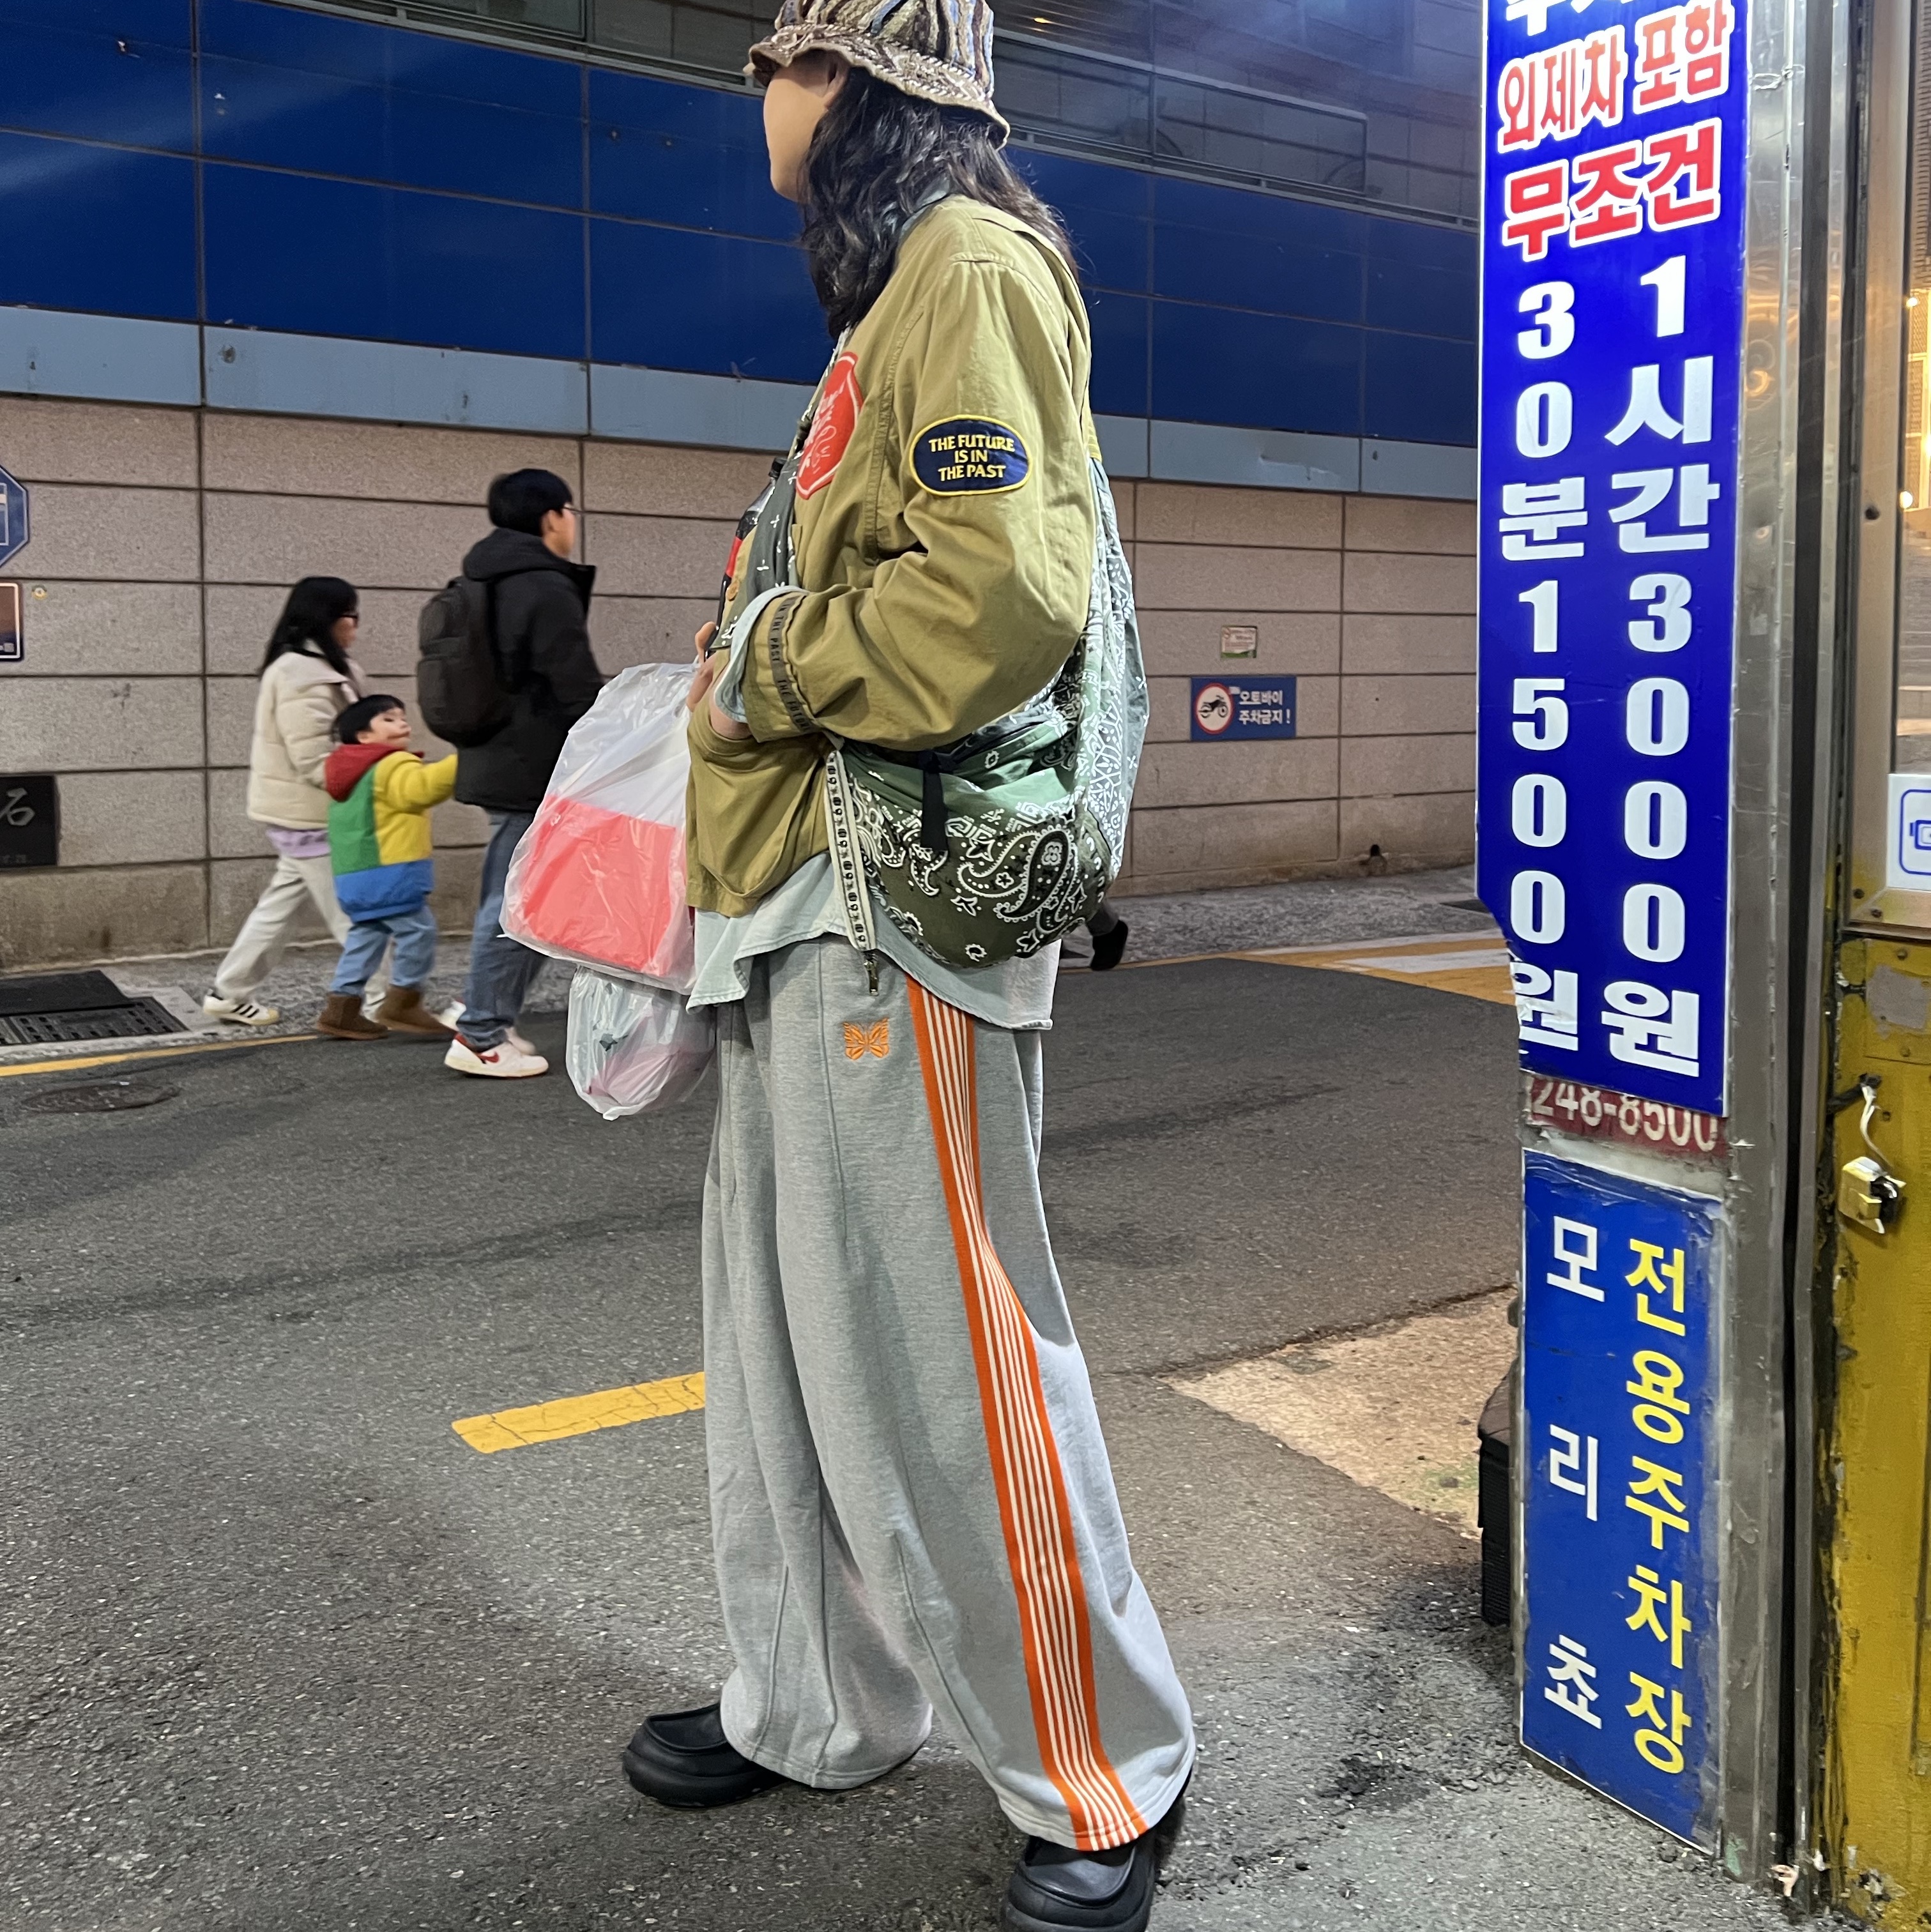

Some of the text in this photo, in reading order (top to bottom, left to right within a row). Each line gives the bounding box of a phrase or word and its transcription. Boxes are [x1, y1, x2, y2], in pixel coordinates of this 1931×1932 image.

[1502, 0, 1728, 147] 외제차 포함
[1507, 125, 1716, 255] 무조건
[928, 434, 1016, 452] THE FUTURE
[954, 449, 988, 464] IS IN
[938, 464, 1007, 482] THE PAST
[770, 637, 781, 662] PAST
[1239, 690, 1283, 706] 오토바이
[1625, 1238, 1693, 1774] 전용주차장
